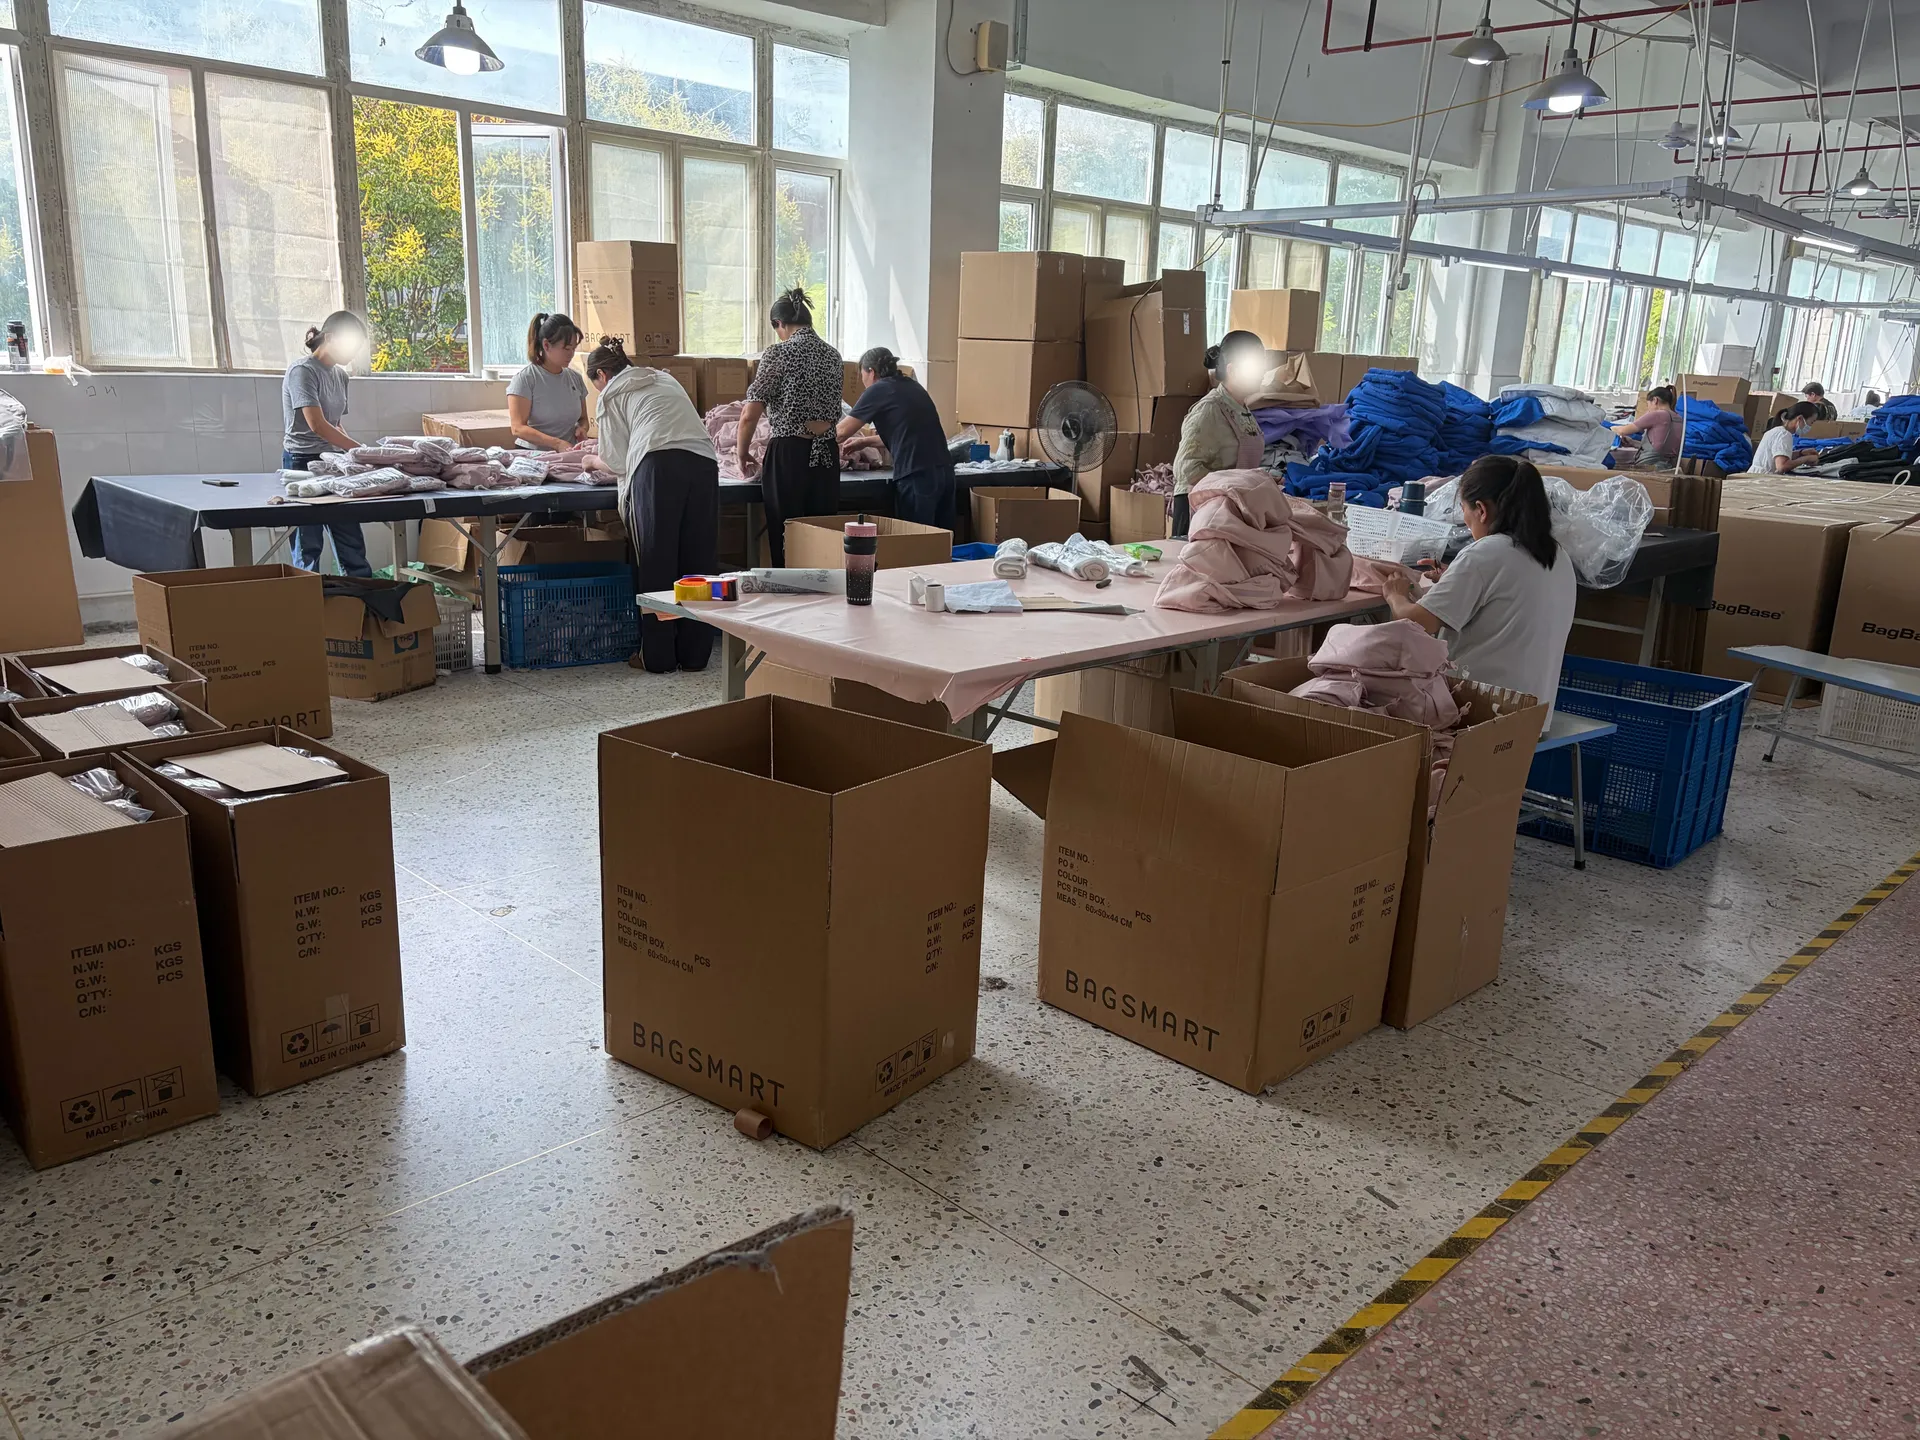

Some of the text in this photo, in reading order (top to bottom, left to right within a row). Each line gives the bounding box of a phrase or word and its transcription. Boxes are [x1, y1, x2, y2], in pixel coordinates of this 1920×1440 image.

[189, 644, 205, 652] ITEM
[191, 659, 220, 668] COLOUR
[1058, 845, 1076, 859] ITEM
[1077, 852, 1090, 864] NO.
[1058, 857, 1068, 867] PO
[1057, 869, 1088, 887] COLOUR
[1384, 882, 1396, 894] KGS
[293, 886, 345, 905] ITEM NO.:
[617, 884, 634, 899] ITEM
[635, 891, 648, 904] NO.
[1353, 882, 1367, 896] ITEM
[295, 889, 382, 919] N.W: KGS
[617, 897, 627, 908] PO
[629, 902, 633, 910] #
[1056, 892, 1077, 907] MEAS
[1085, 903, 1118, 924] 60x50x44
[1120, 917, 1133, 929] CM
[1057, 880, 1072, 893] PCS
[1072, 886, 1088, 899] PER
[1089, 893, 1105, 906] BOX
[1135, 910, 1152, 923] PCS
[1382, 894, 1394, 906] KGS
[296, 902, 382, 932] G.W: KGS
[617, 910, 647, 930] COLOUR
[927, 902, 957, 921] ITEM NO.:
[927, 903, 976, 935] N.W: KGS
[1381, 907, 1392, 918] PCS
[297, 915, 382, 945] Q'TY: PCS
[926, 916, 976, 948] G.W: KGS
[962, 929, 974, 943] PCS
[70, 938, 136, 960] ITEM NO.:
[298, 946, 321, 959] C/N:
[617, 922, 632, 936] PCS
[633, 929, 648, 943] PER
[649, 936, 665, 950] BOX
[694, 953, 711, 968] PCS
[617, 935, 638, 951] MEAS
[647, 948, 680, 968] 60x50x44
[681, 962, 694, 974] CM
[72, 941, 182, 975] N.W: KGS
[75, 955, 184, 989] G.W: KGS
[77, 970, 184, 1004] Q'TY: PCS
[79, 1005, 106, 1019] C/N:
[1065, 969, 1220, 1052] BAGSMART
[299, 1041, 366, 1068] MADE IN CHINA
[633, 1021, 785, 1108] BAGSMART
[85, 1122, 118, 1140] MADE
[134, 1107, 169, 1124] CHINA
